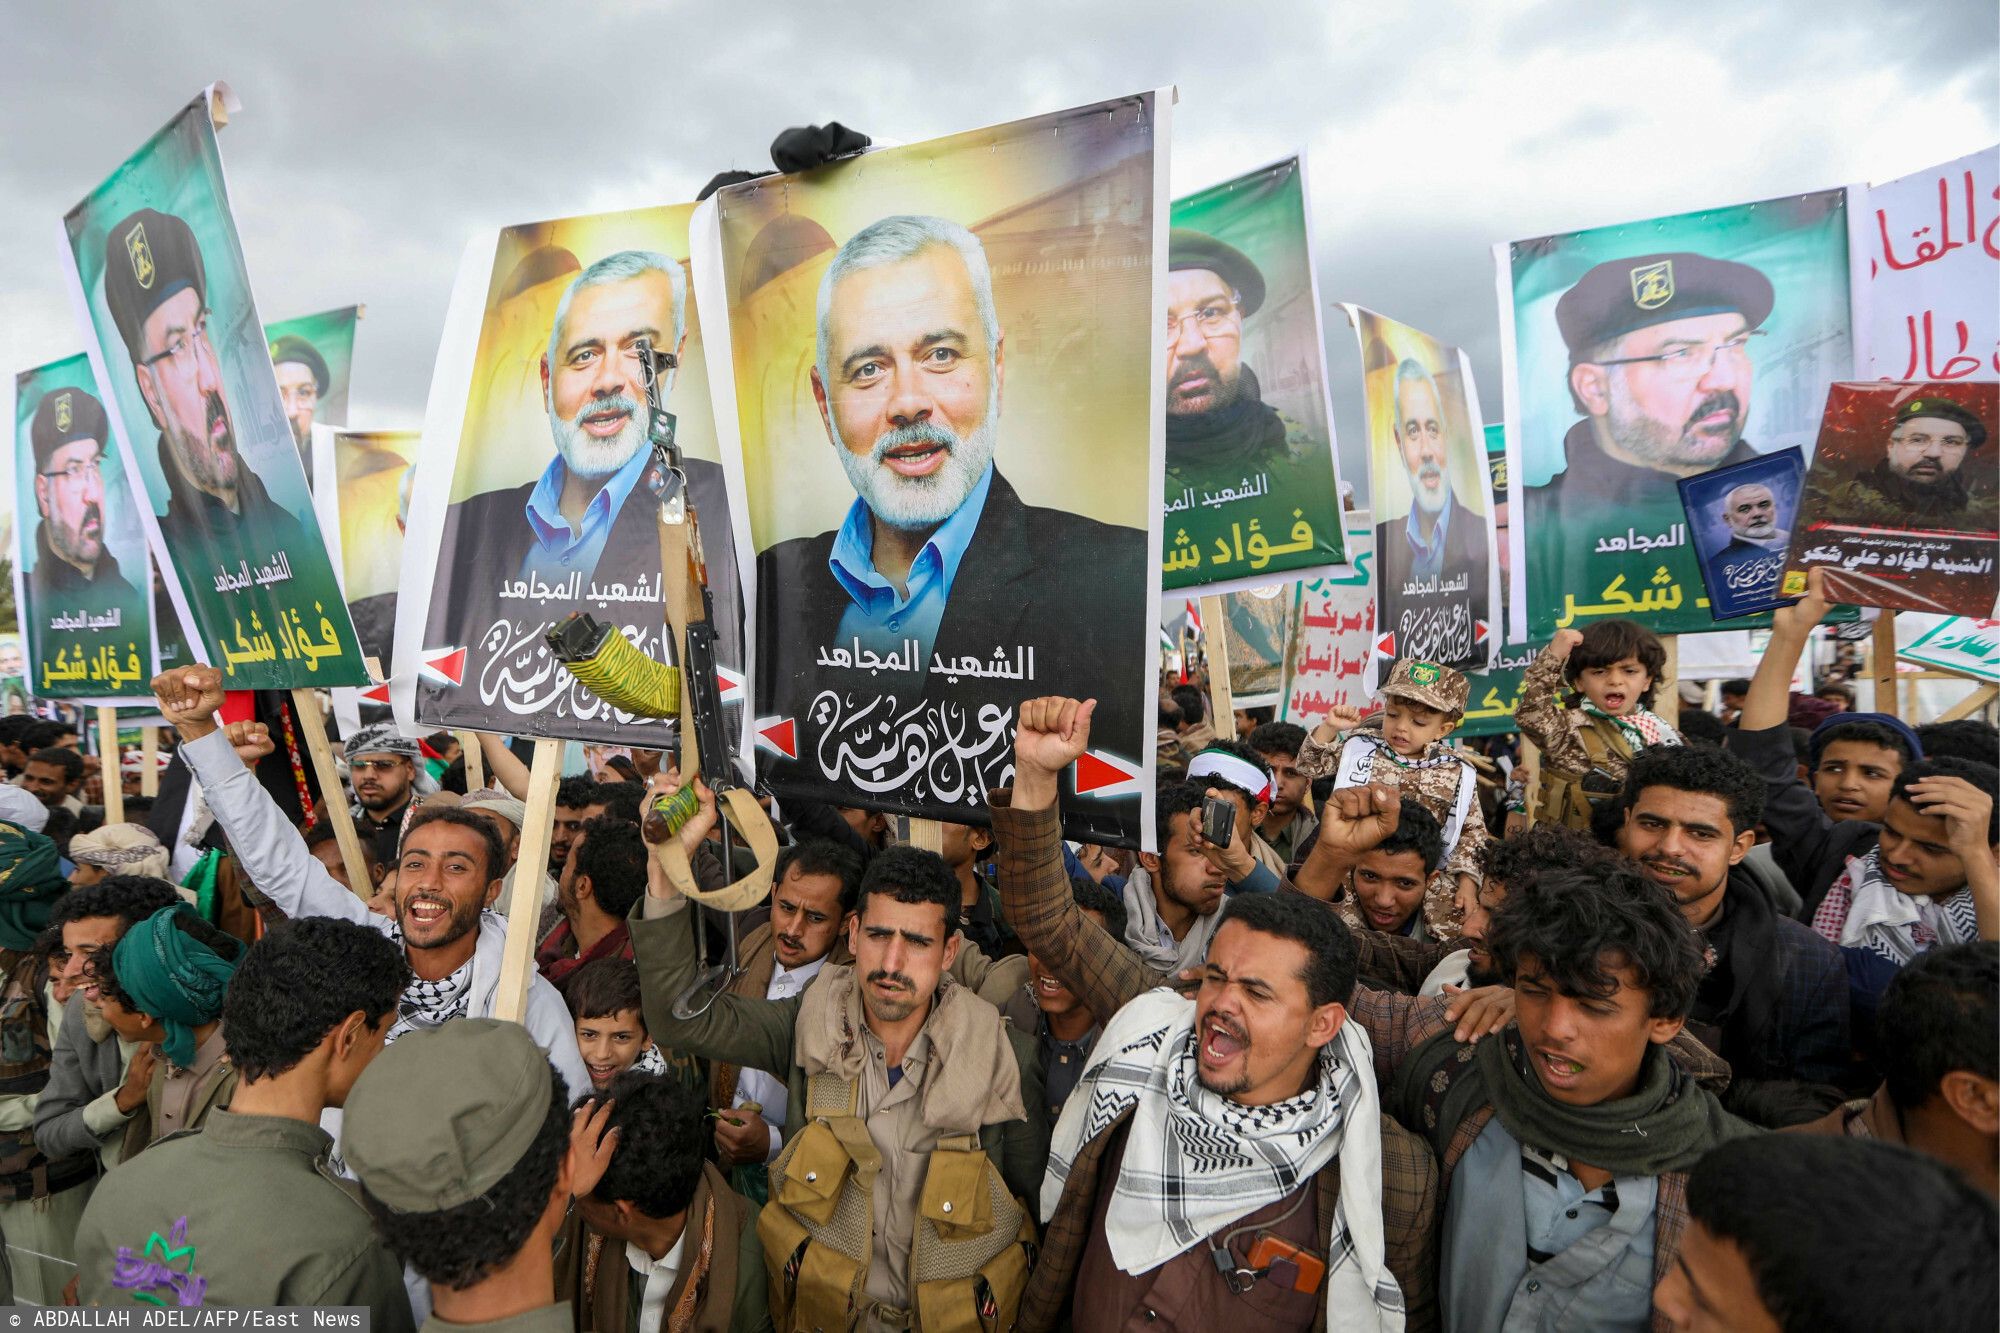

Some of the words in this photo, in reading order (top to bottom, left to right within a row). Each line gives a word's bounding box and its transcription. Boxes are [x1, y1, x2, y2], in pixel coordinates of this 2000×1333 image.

[1201, 473, 1269, 509] الشهيد
[1211, 507, 1314, 570] فؤاد
[1594, 523, 1686, 554] المجاهد
[1799, 545, 1843, 564] شكر
[212, 559, 253, 594] المجاهد
[254, 550, 293, 591] الشهيد
[1842, 548, 1880, 571] علي
[1883, 549, 1930, 572] فؤاد
[499, 570, 582, 606] المجاهد
[586, 572, 666, 609] لشهيد
[1402, 573, 1438, 598] المجاهد
[1439, 572, 1469, 597] الشهيد
[1555, 565, 1684, 629] شكر
[51, 609, 88, 632] المجاهد
[87, 608, 122, 632] الشهيد
[278, 600, 343, 672] فؤاد
[219, 609, 277, 677] شكر
[816, 636, 920, 676] المجاهد
[42, 643, 88, 689] شكر
[90, 642, 142, 689] فؤاد
[929, 645, 1035, 684] الشهيد
